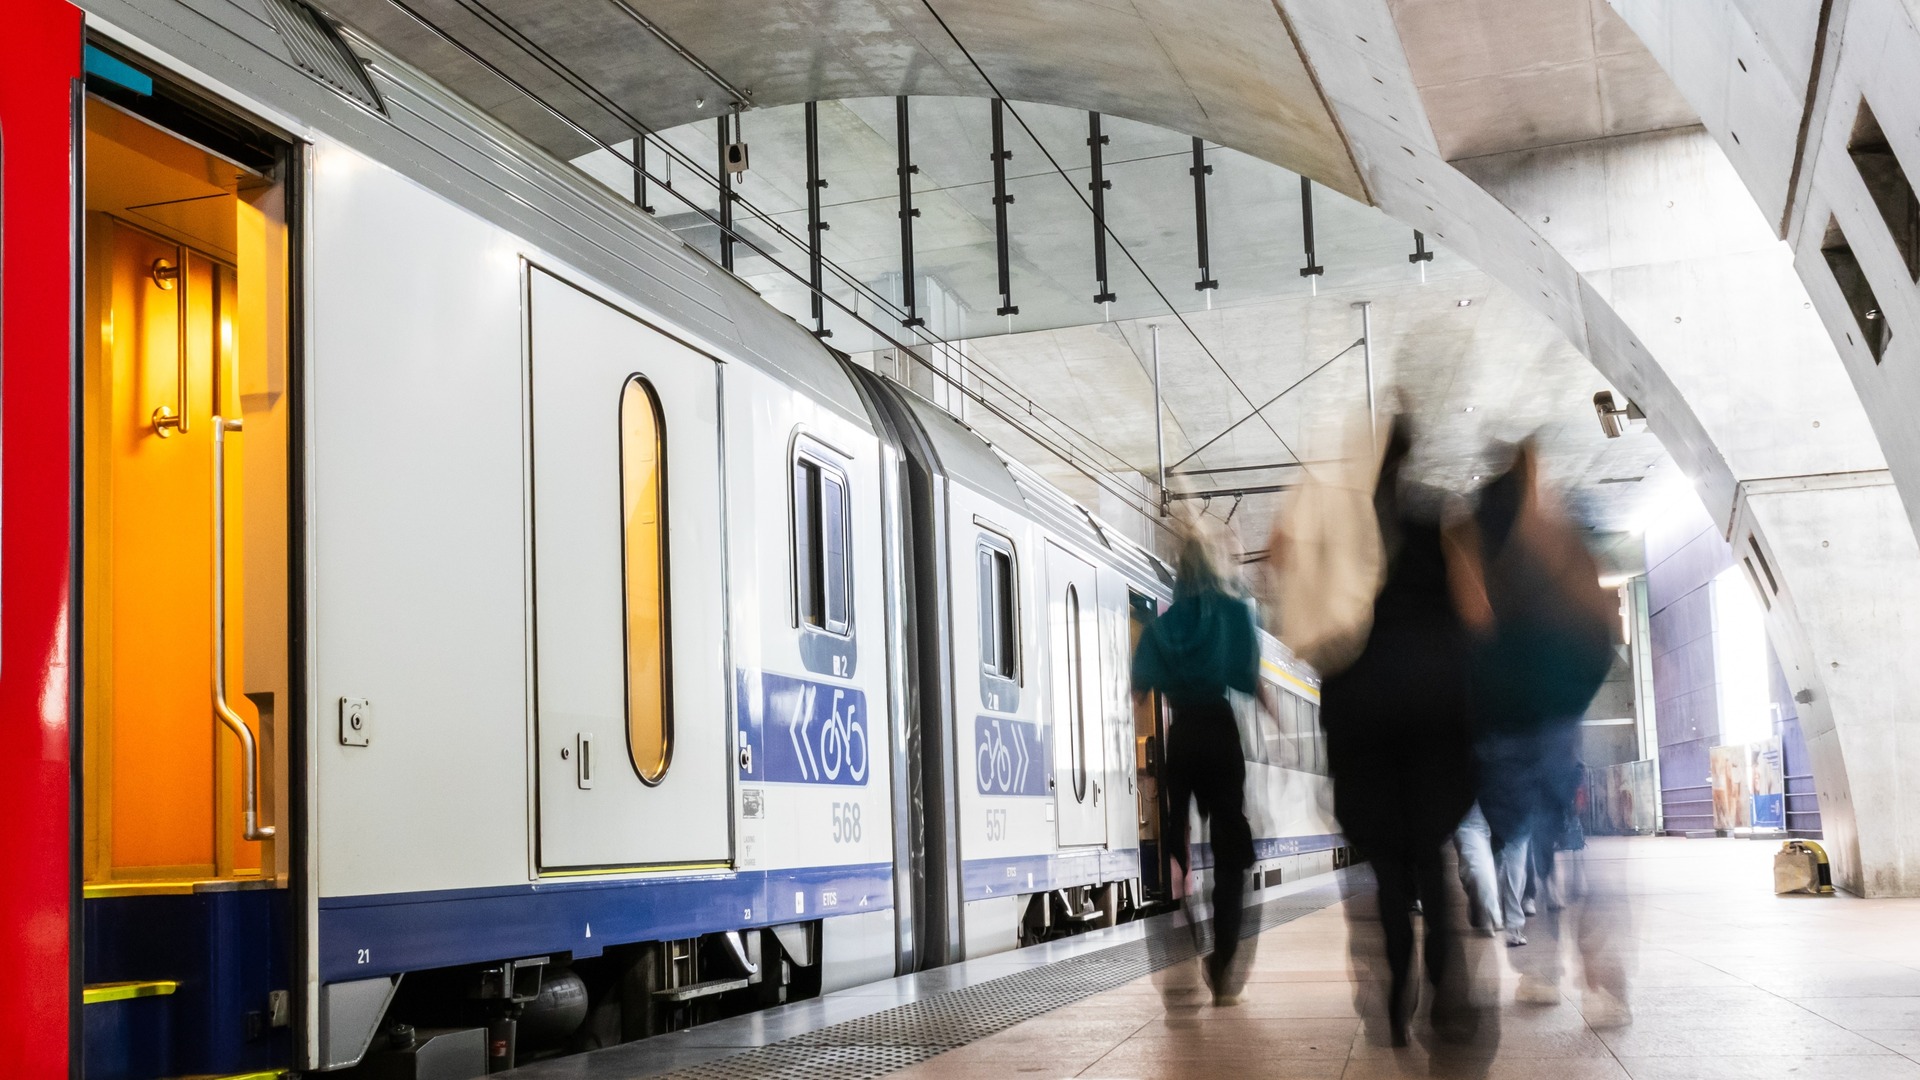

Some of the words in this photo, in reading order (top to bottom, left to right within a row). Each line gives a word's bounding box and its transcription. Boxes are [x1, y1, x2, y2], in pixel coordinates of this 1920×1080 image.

[841, 655, 848, 677] 2
[832, 802, 861, 843] 568
[986, 809, 1007, 841] 557
[822, 892, 837, 906] ETCS
[744, 909, 752, 919] 23
[358, 949, 370, 964] 21
